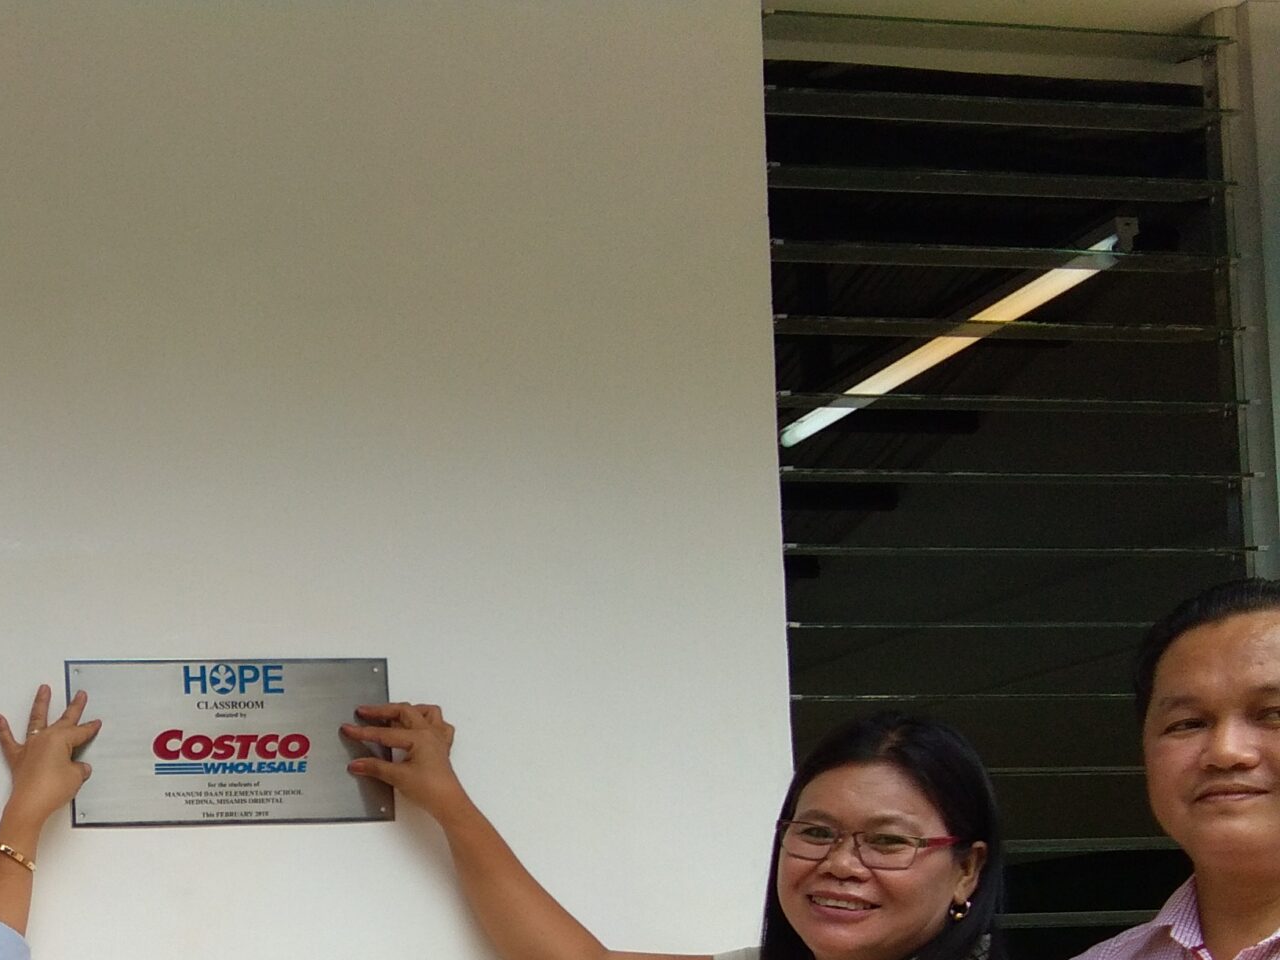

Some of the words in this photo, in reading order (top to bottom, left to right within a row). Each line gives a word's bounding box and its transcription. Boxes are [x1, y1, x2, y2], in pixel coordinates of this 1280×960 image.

[183, 664, 285, 695] HOPE
[197, 700, 265, 710] CLASSROOM
[152, 729, 310, 760] COSTCO
[203, 761, 307, 774] WHOLESALE
[225, 789, 272, 797] ELEMENTARY
